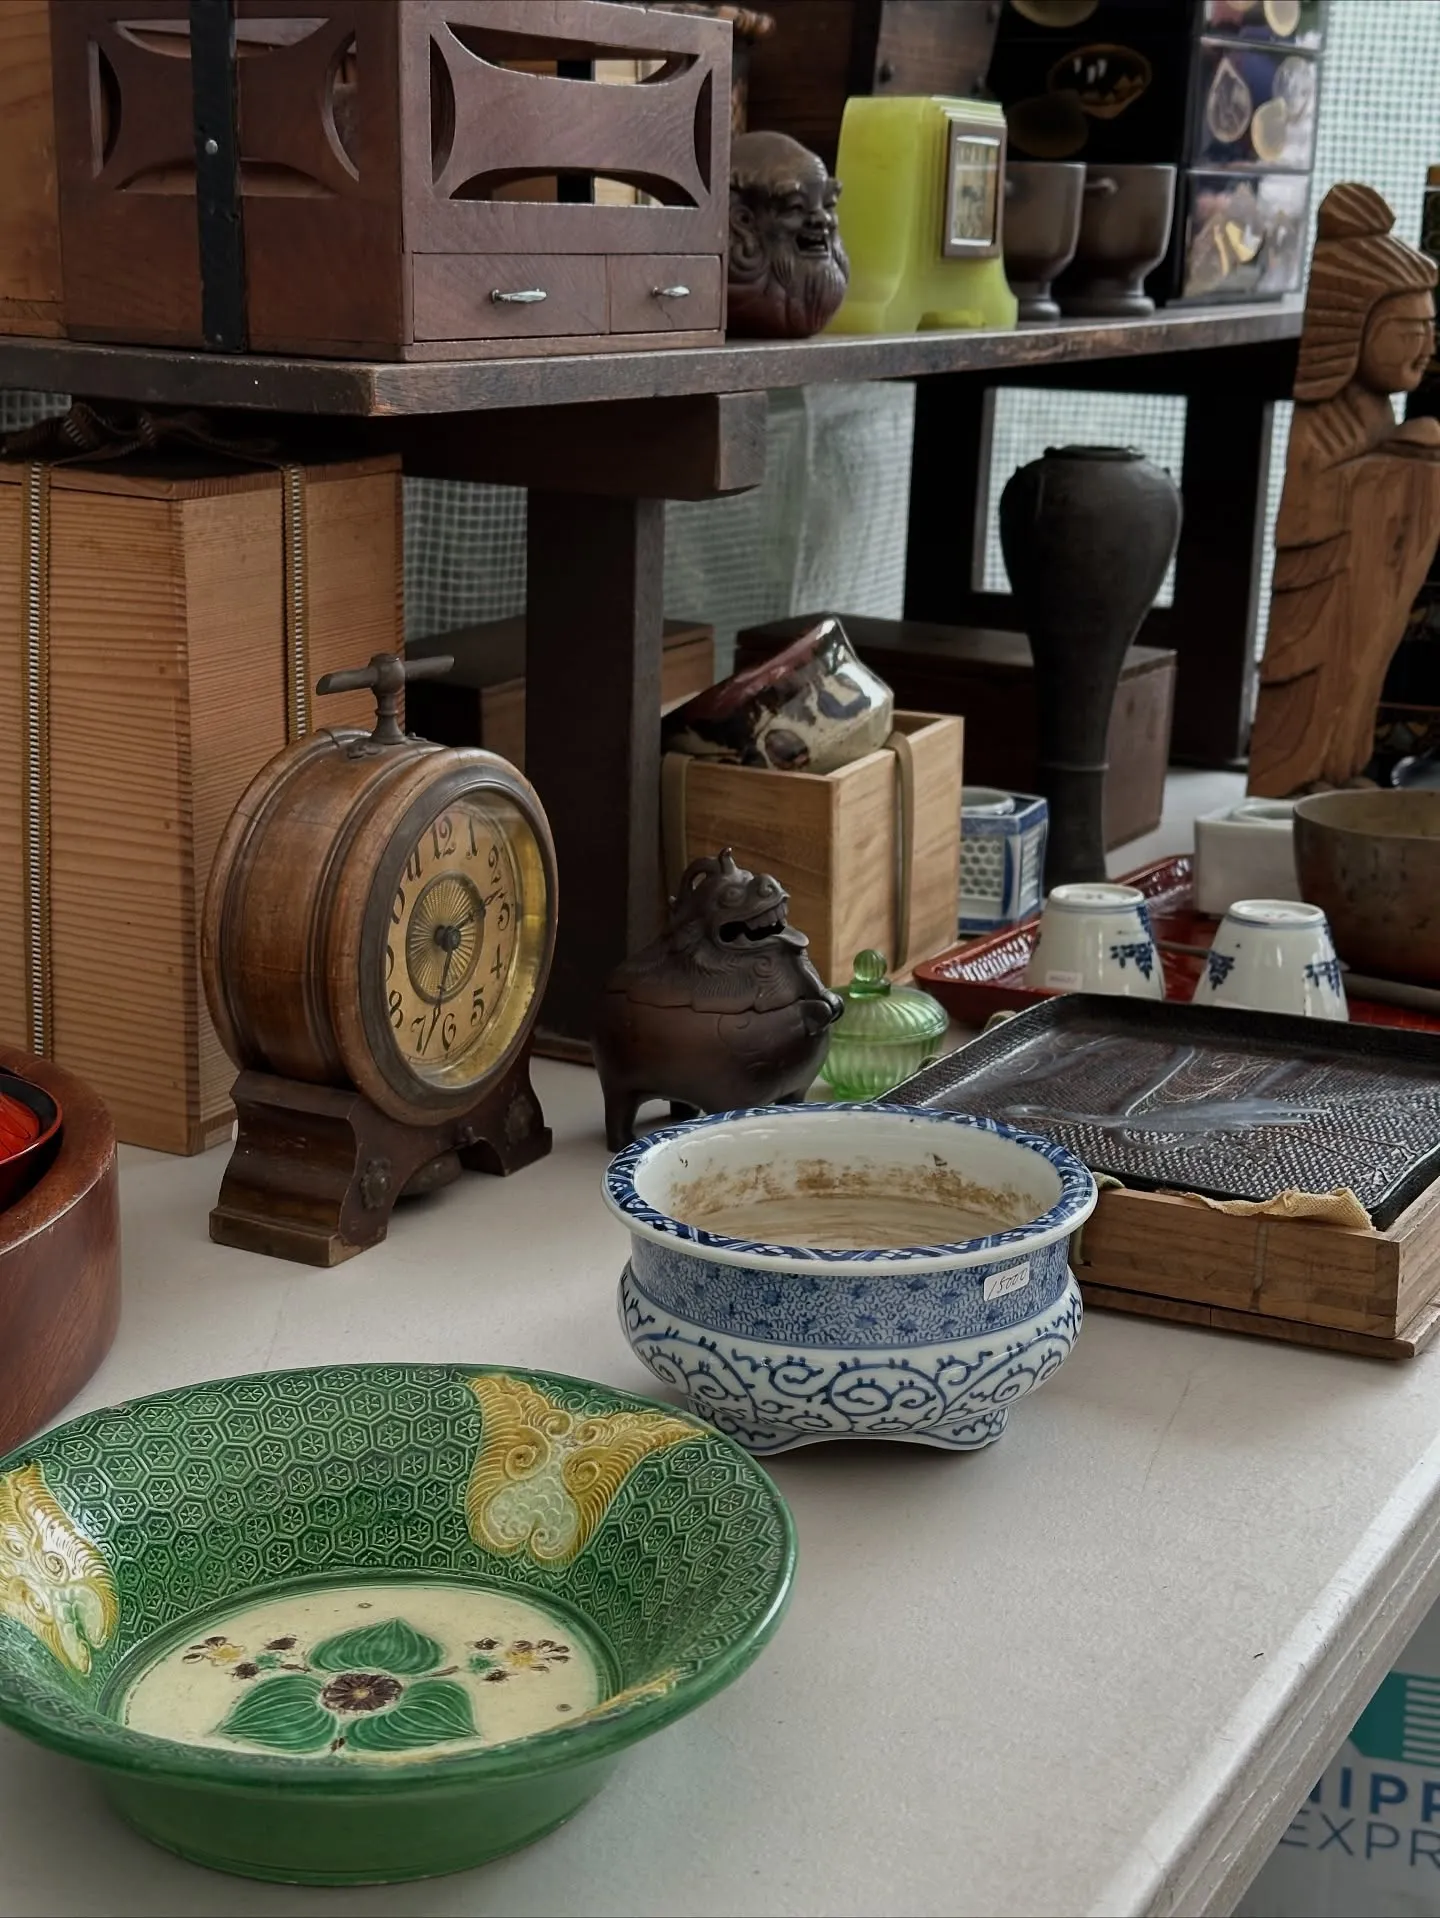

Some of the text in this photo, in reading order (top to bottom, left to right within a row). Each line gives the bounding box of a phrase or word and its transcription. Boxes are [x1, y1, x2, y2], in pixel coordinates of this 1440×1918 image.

[430, 816, 456, 860] 12
[488, 845, 501, 885] 2
[490, 943, 503, 979] 4
[388, 990, 403, 1028] 8
[470, 987, 485, 1026] 5
[410, 1015, 426, 1052] 7
[442, 1013, 456, 1051] 6
